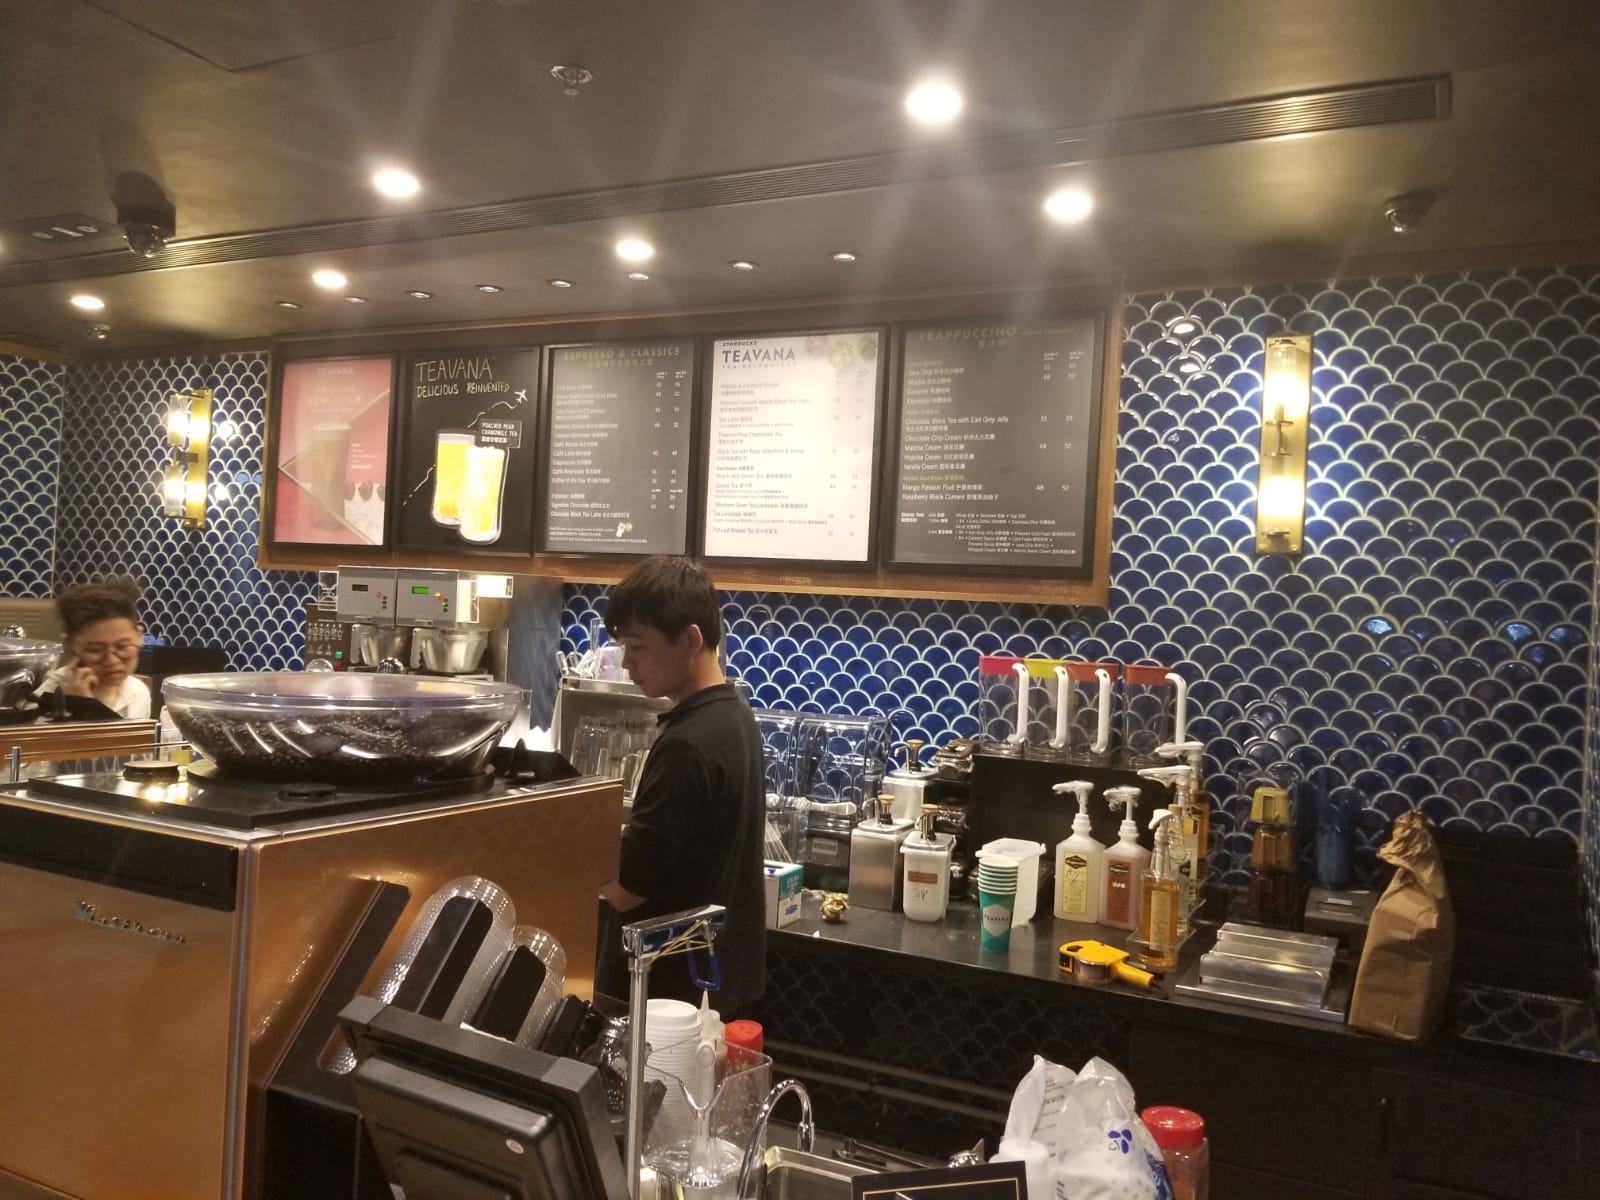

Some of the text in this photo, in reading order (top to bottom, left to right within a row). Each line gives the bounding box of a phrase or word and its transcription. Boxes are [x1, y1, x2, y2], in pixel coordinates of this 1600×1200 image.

[919, 326, 1017, 342] FRAPPUCCINO
[564, 350, 614, 361] ESPRESSO
[630, 345, 680, 358] CLASSICS
[722, 348, 796, 363] TEAVANA
[415, 357, 493, 383] TEAVANA
[417, 381, 510, 398] DELICIOUS REINVENTED
